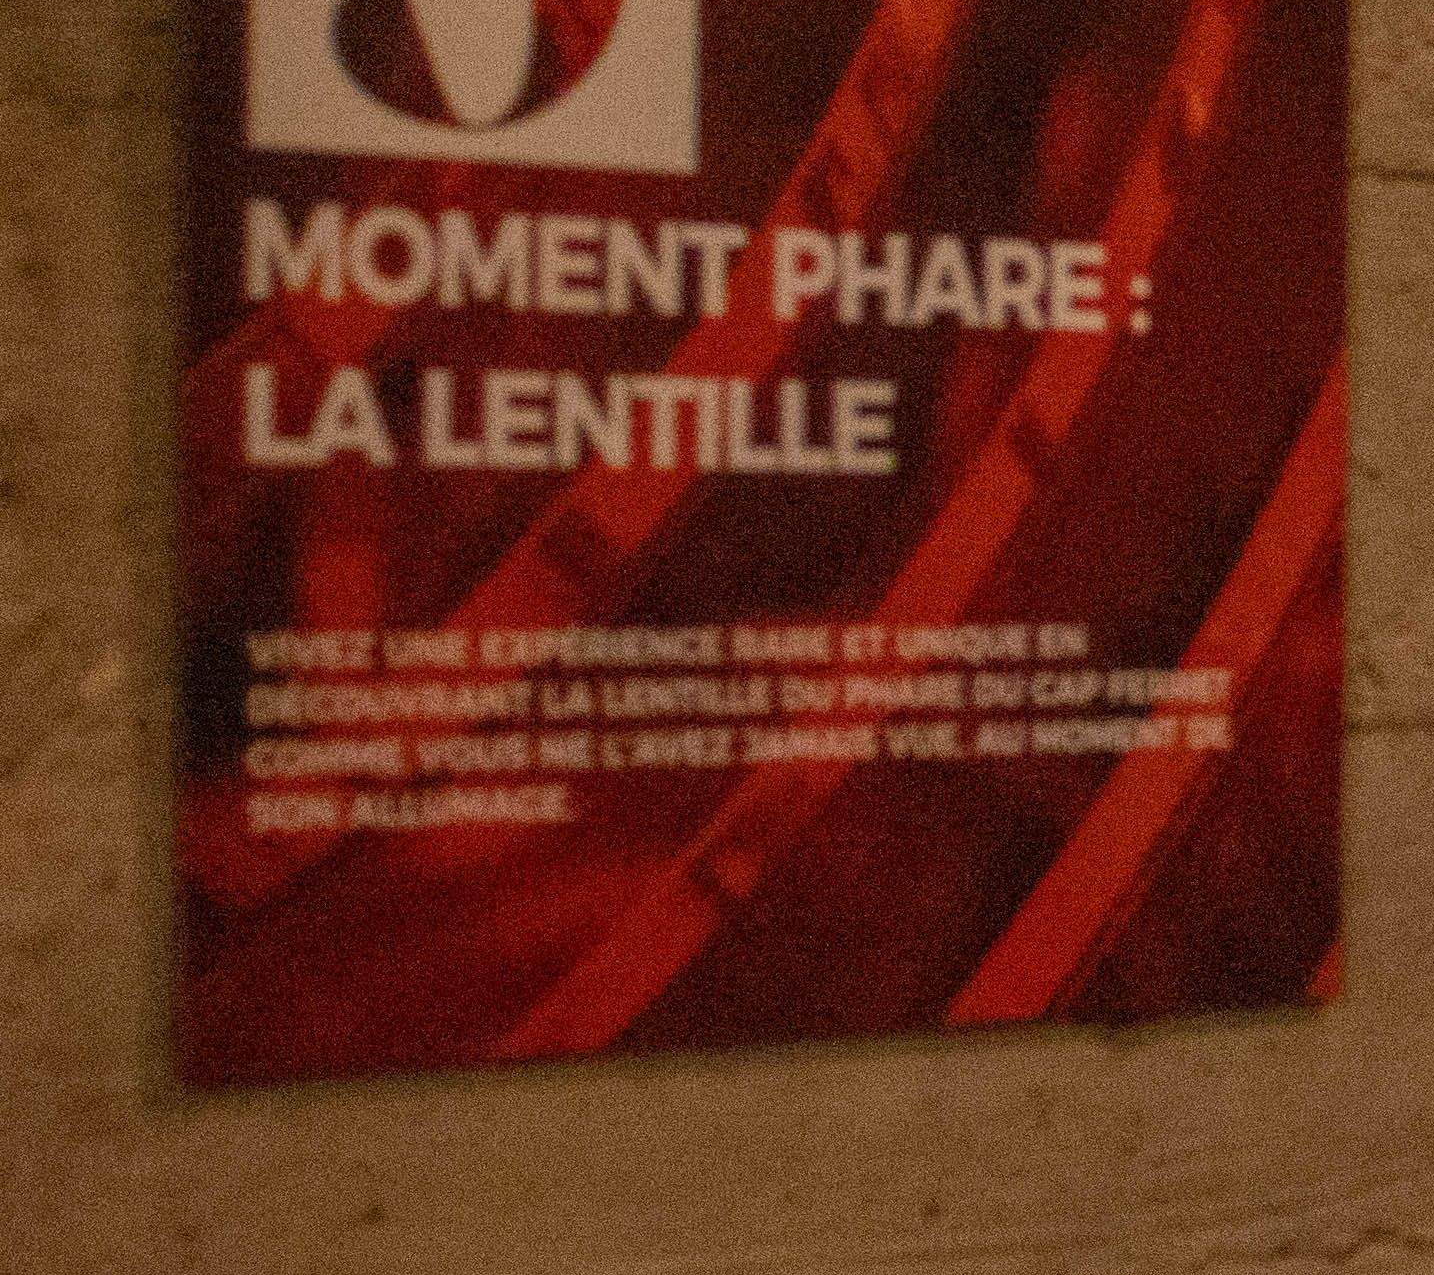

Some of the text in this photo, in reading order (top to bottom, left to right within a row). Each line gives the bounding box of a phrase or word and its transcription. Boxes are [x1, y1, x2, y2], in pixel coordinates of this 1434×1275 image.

[245, 198, 749, 321] MOMENT
[770, 224, 1110, 333] PHARE
[243, 364, 899, 475] LA LENTILLE
